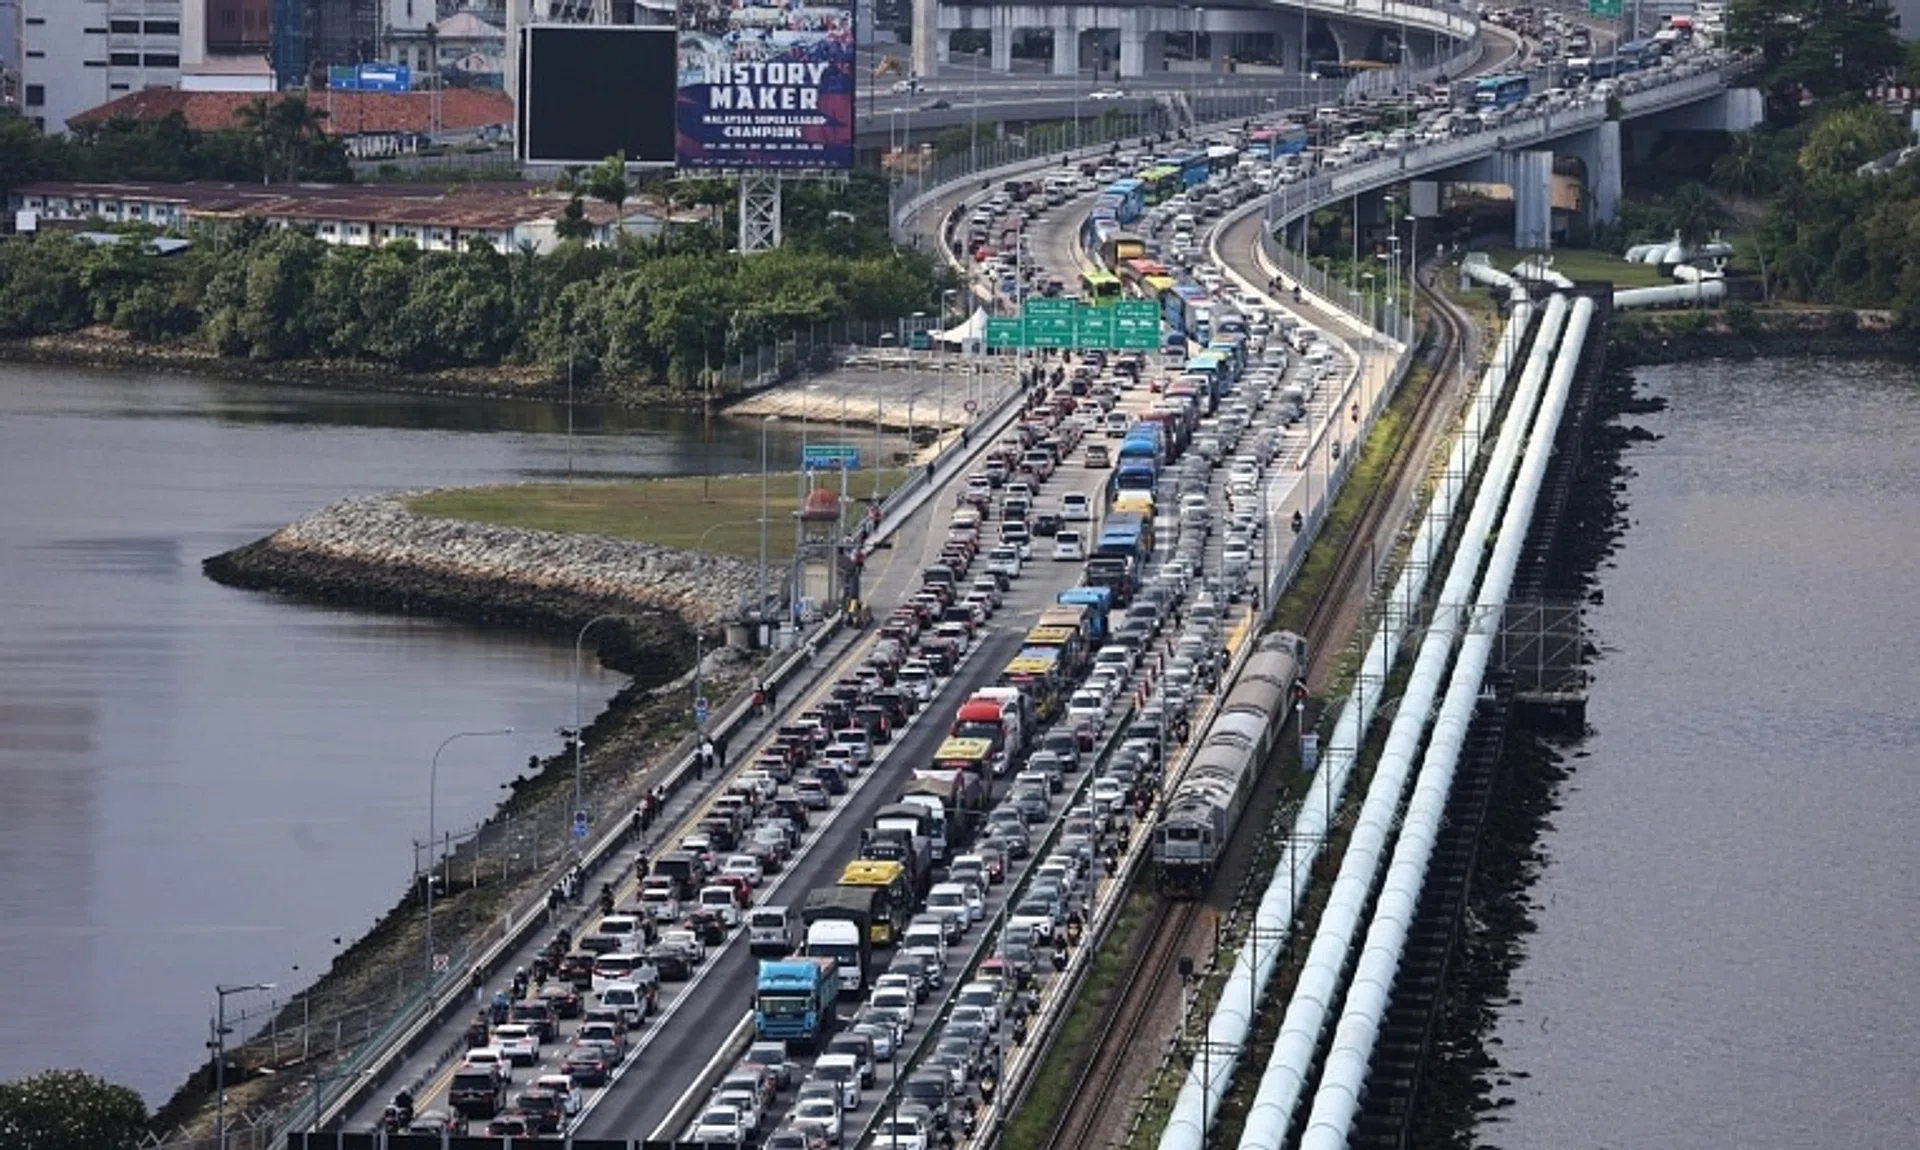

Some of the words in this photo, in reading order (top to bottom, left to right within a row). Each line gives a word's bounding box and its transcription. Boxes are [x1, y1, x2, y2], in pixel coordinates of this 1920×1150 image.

[703, 62, 830, 85] HISTORY
[710, 86, 818, 110] MAKER
[702, 115, 753, 125] MALAYSIA
[754, 115, 786, 125] SUPER
[723, 126, 802, 138] CHAMPIONS
